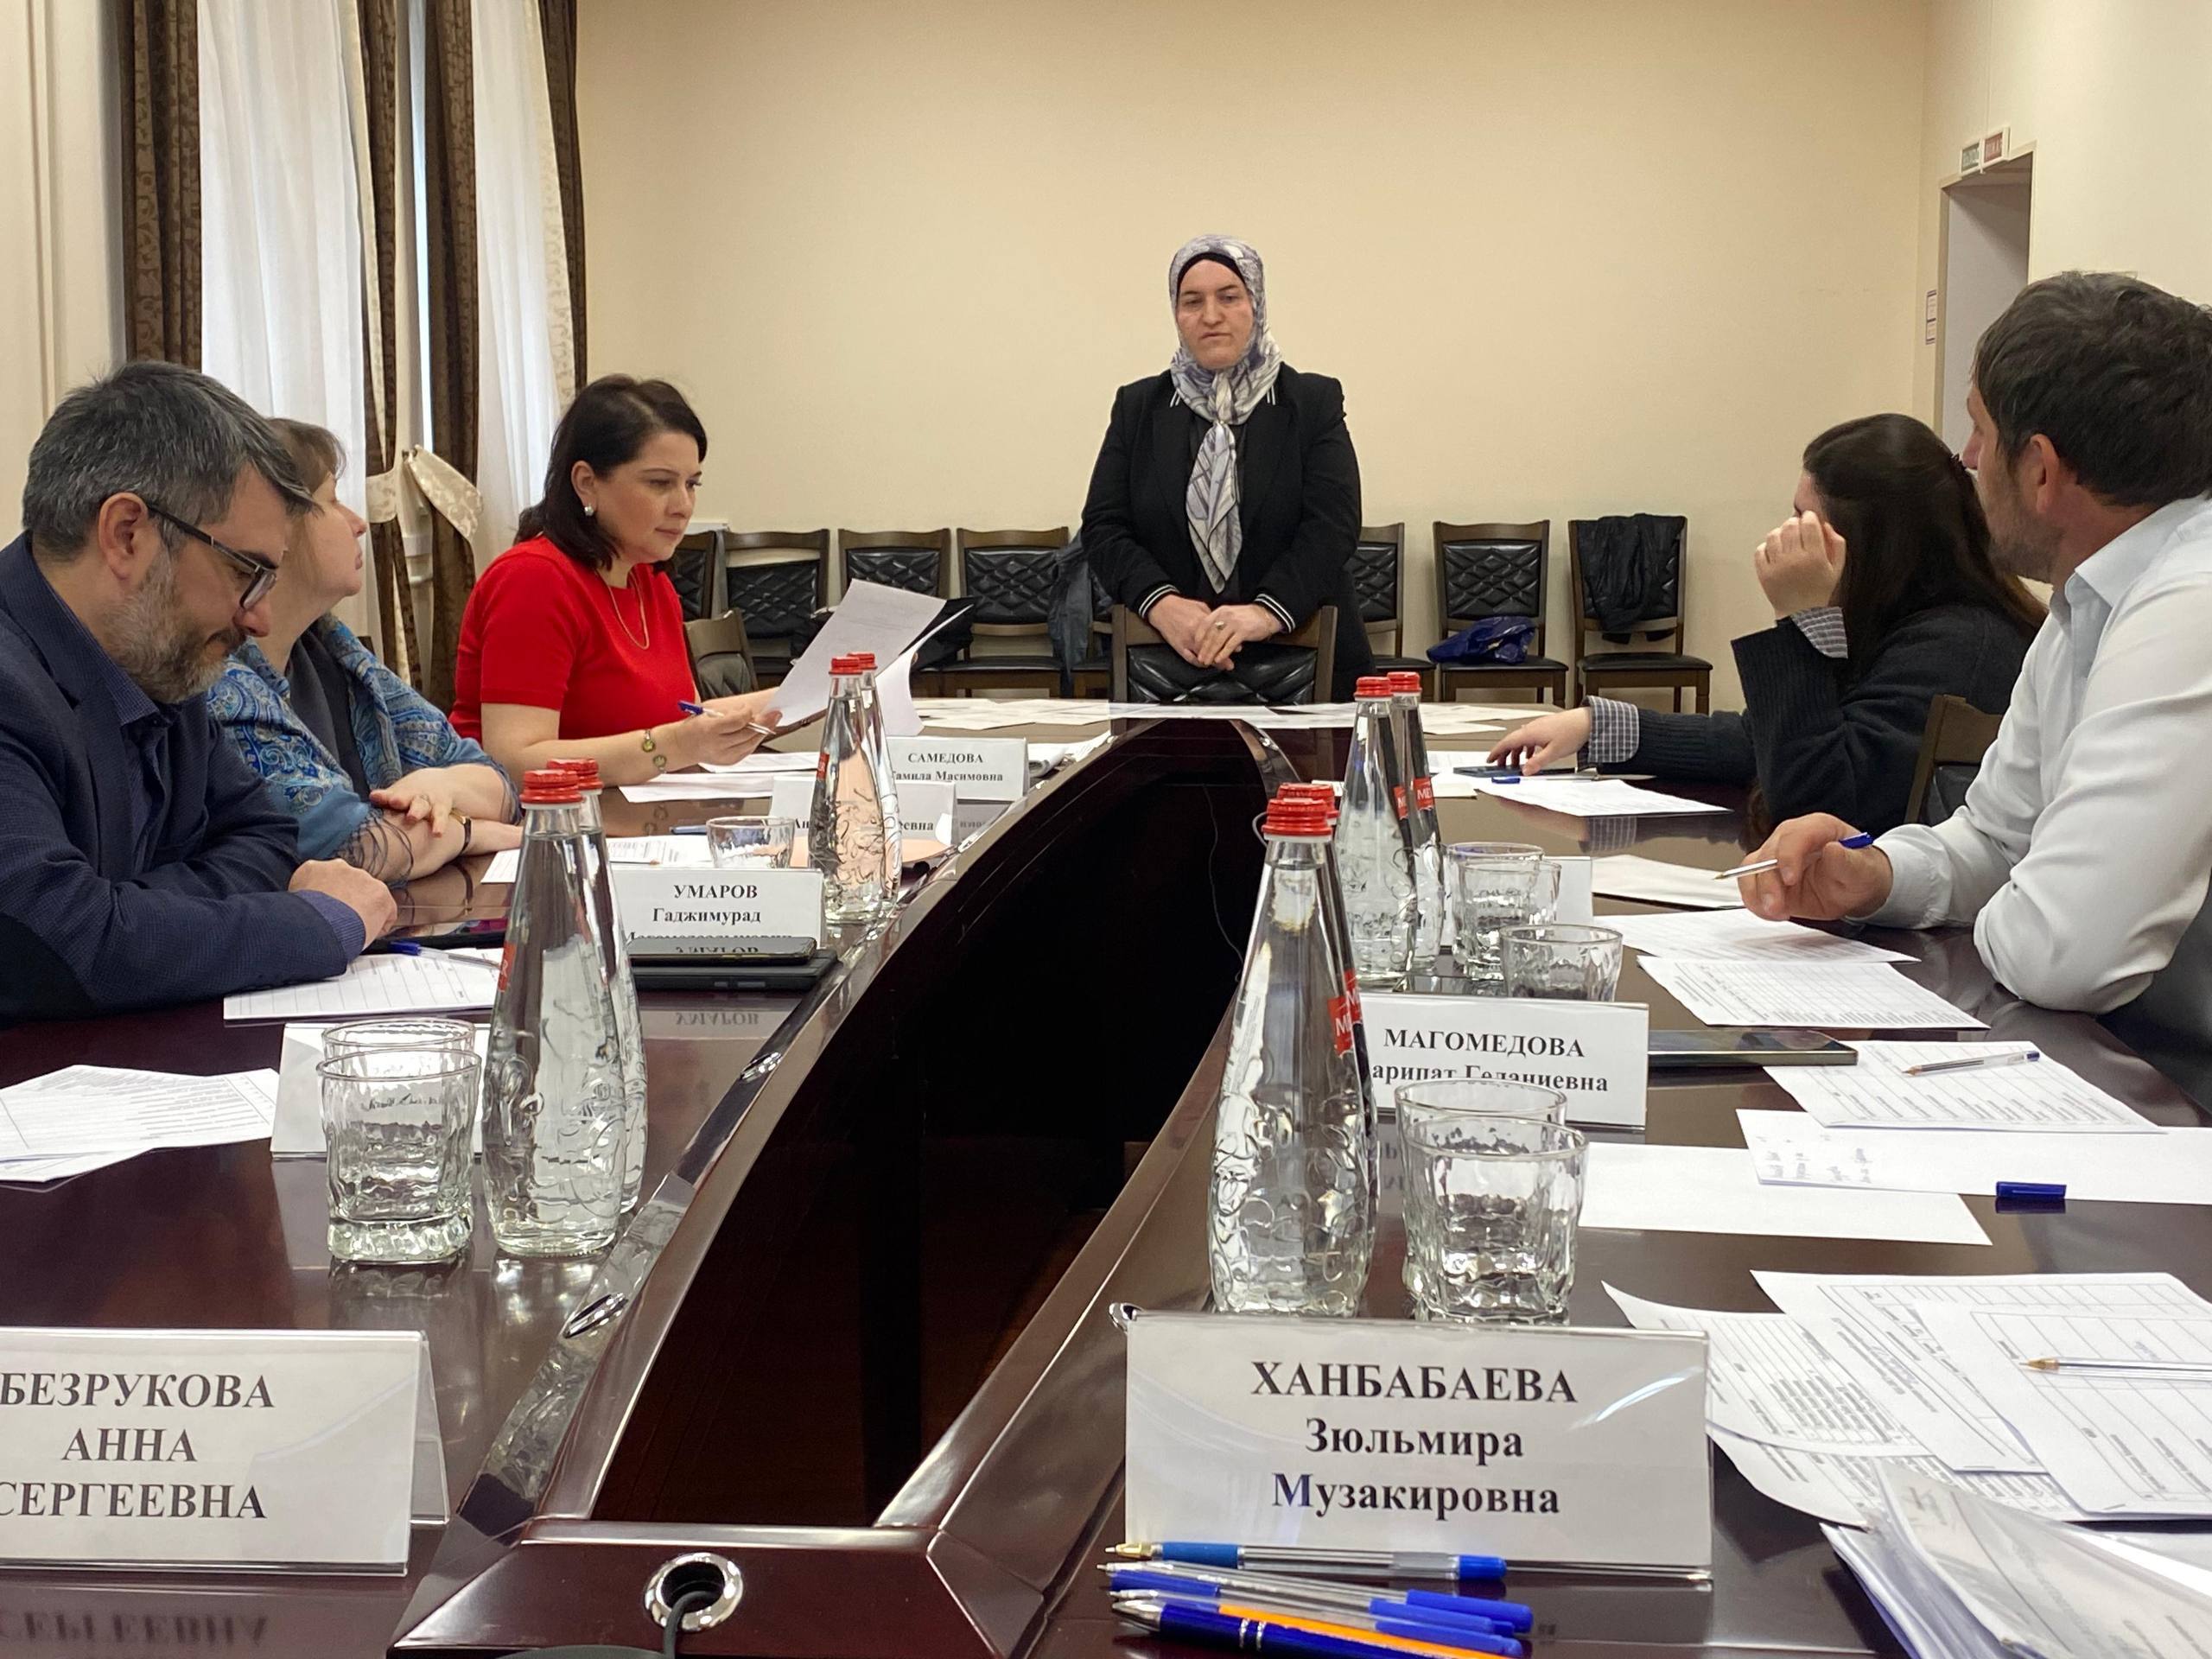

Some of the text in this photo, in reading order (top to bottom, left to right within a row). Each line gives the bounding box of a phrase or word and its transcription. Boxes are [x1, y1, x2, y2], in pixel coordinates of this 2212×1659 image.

[907, 753, 983, 764] САМЕДОВА
[936, 771, 1003, 781] Масимовна
[674, 885, 758, 899] УМАРОВ
[653, 908, 761, 925] Гаджимурад
[1382, 1027, 1586, 1058] МАГОМЕДОВА
[1371, 1064, 1458, 1085] арипат
[0, 1372, 274, 1408] БЕЗРУКОВА
[1250, 1361, 1578, 1402] ХАНБАБАЕВА
[61, 1427, 198, 1462] АННА
[1305, 1417, 1524, 1466] Зюльмира
[0, 1481, 268, 1519] СЕРГЕЕВНА
[1271, 1471, 1560, 1522] Музакировна
